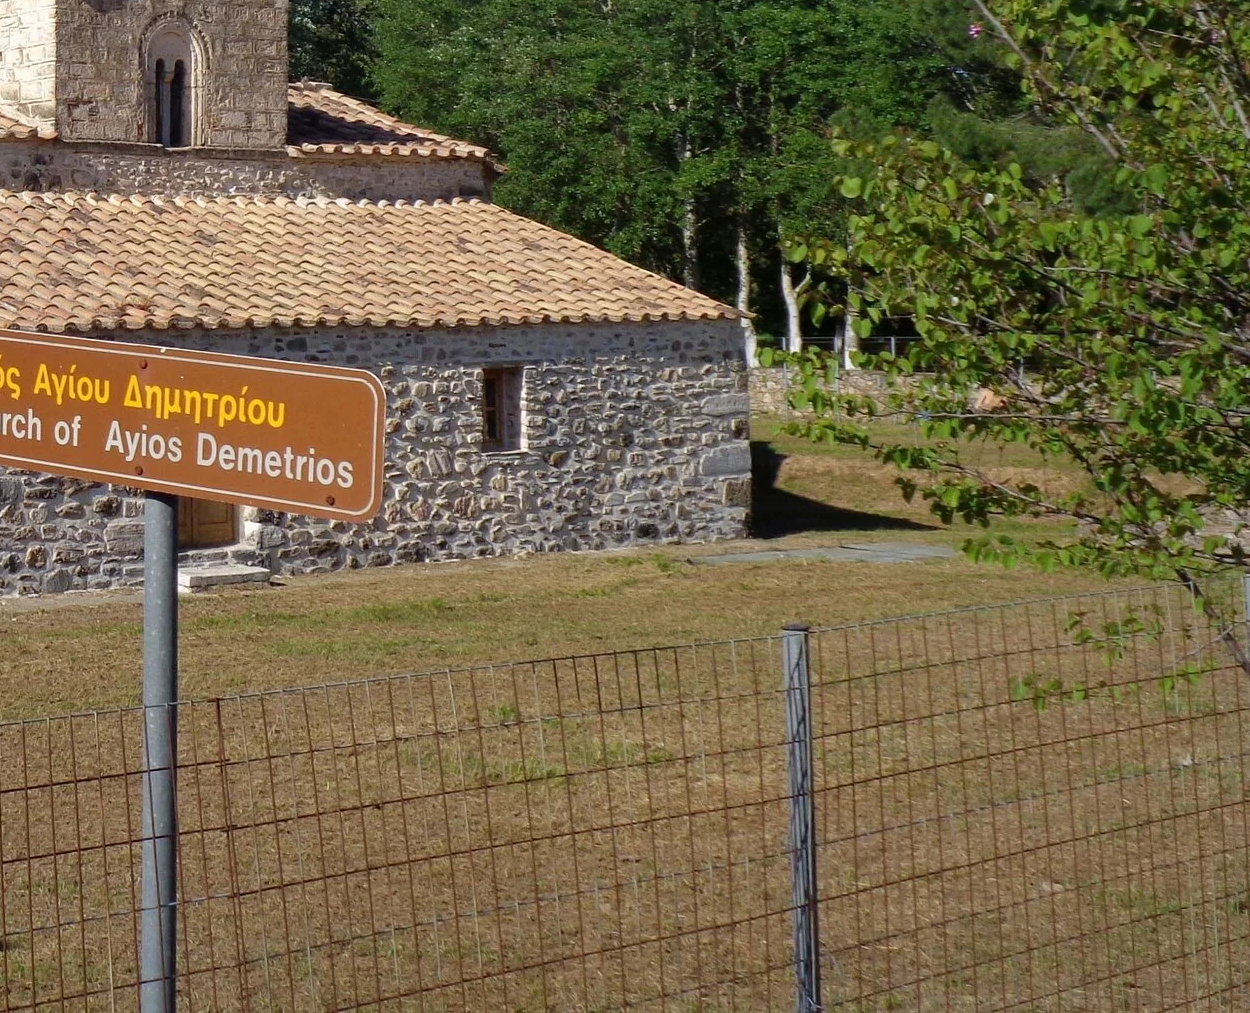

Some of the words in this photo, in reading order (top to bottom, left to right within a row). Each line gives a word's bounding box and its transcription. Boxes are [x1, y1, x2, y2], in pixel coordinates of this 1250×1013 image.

[33, 363, 110, 405] Αγίου
[123, 374, 286, 428] Δημητρίου
[54, 415, 82, 447] of
[105, 420, 183, 462] Ayios
[196, 432, 354, 488] Demetrios
